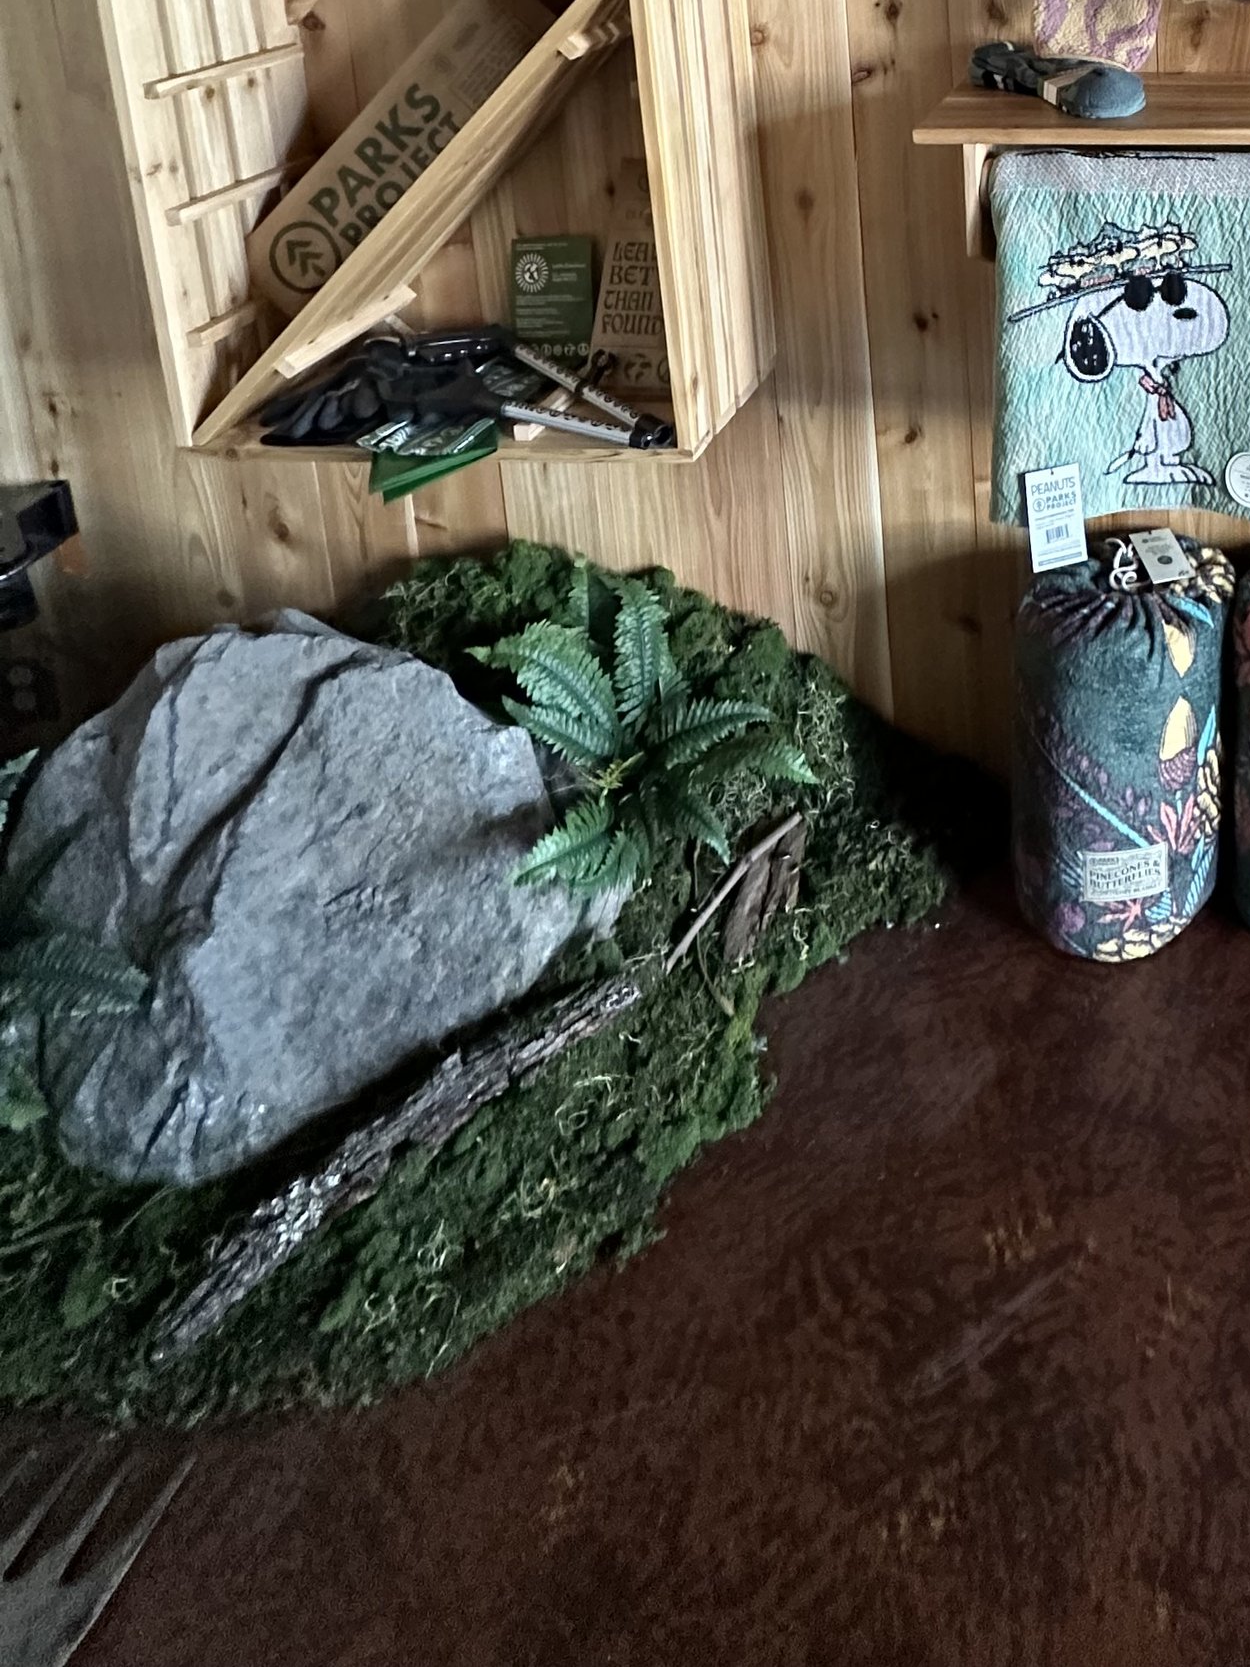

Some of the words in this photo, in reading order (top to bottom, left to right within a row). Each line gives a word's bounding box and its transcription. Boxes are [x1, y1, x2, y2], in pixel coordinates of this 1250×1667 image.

[308, 83, 441, 228] PARKS
[612, 241, 657, 263] LEA
[609, 265, 657, 286] BET
[603, 290, 654, 312] THAN
[601, 313, 665, 335] FOUND
[1030, 476, 1076, 497] PEANUTS
[1046, 491, 1077, 504] PARKS
[1046, 498, 1076, 511] PROJECT
[1089, 860, 1150, 880] PINECONES
[1152, 859, 1160, 867] &
[1089, 868, 1161, 889] BUTTERFLIES
